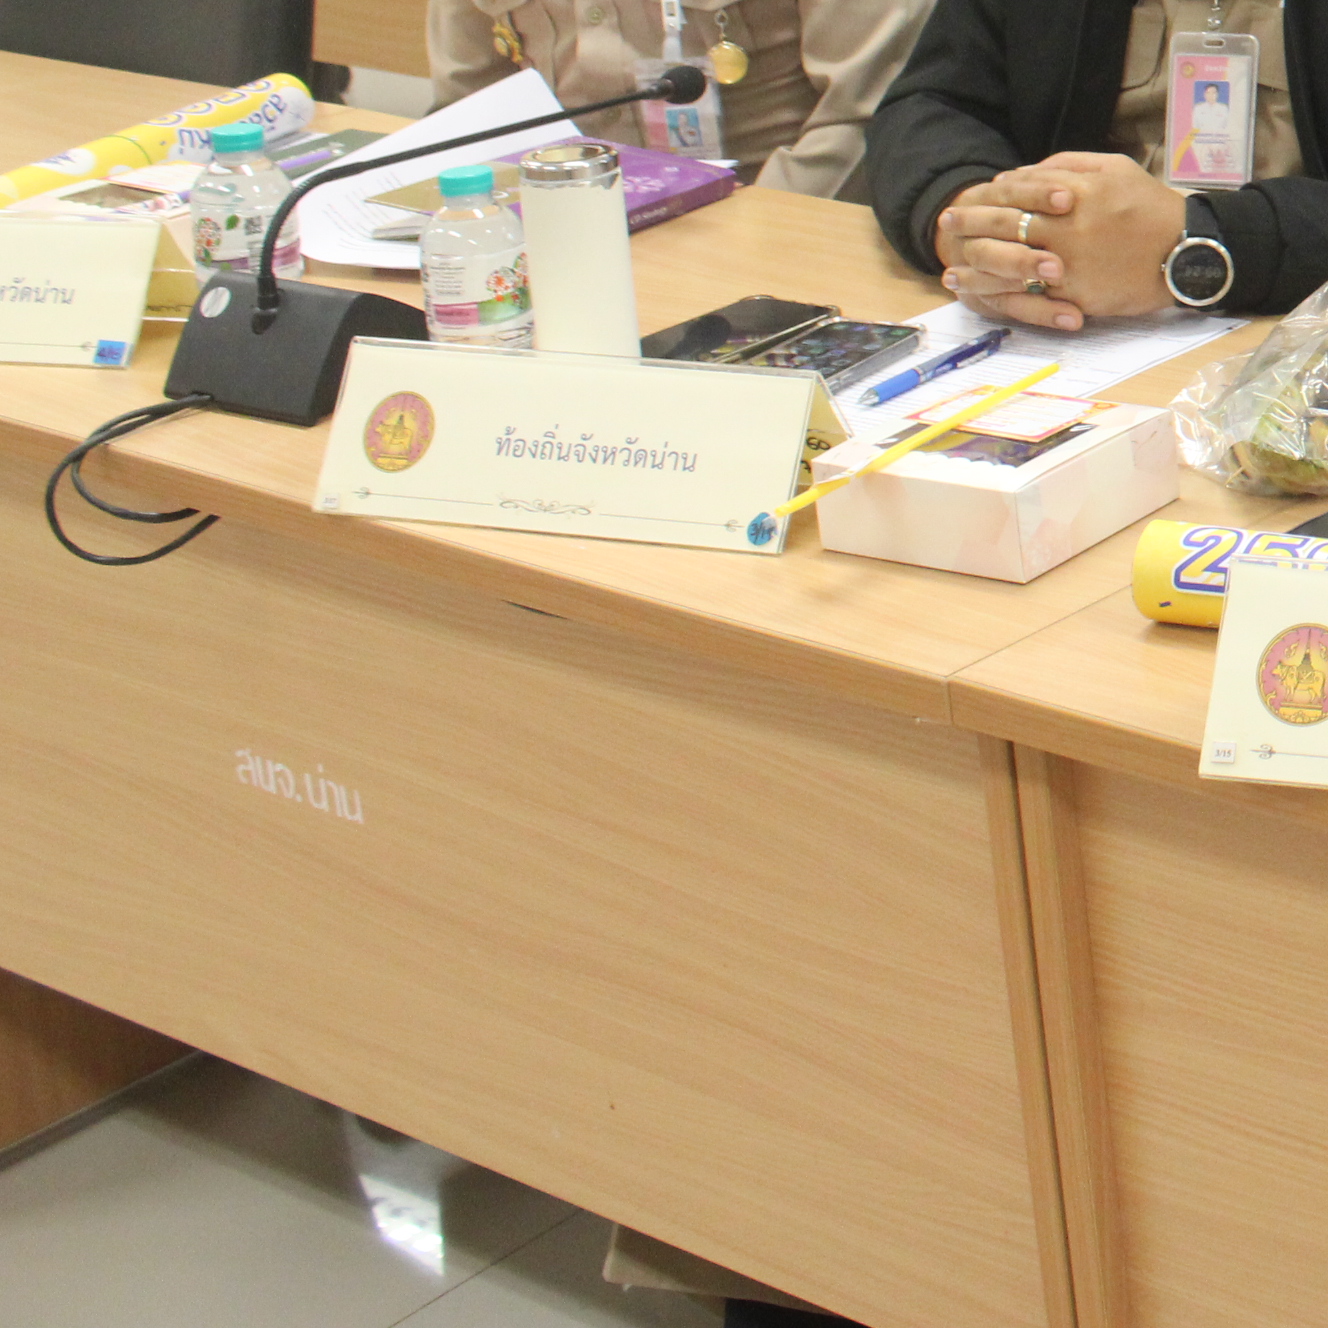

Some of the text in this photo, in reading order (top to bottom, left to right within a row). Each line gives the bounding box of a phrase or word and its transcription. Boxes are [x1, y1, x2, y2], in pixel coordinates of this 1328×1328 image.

[494, 423, 698, 473] ท้องถิ่นจังหวัดน่าน
